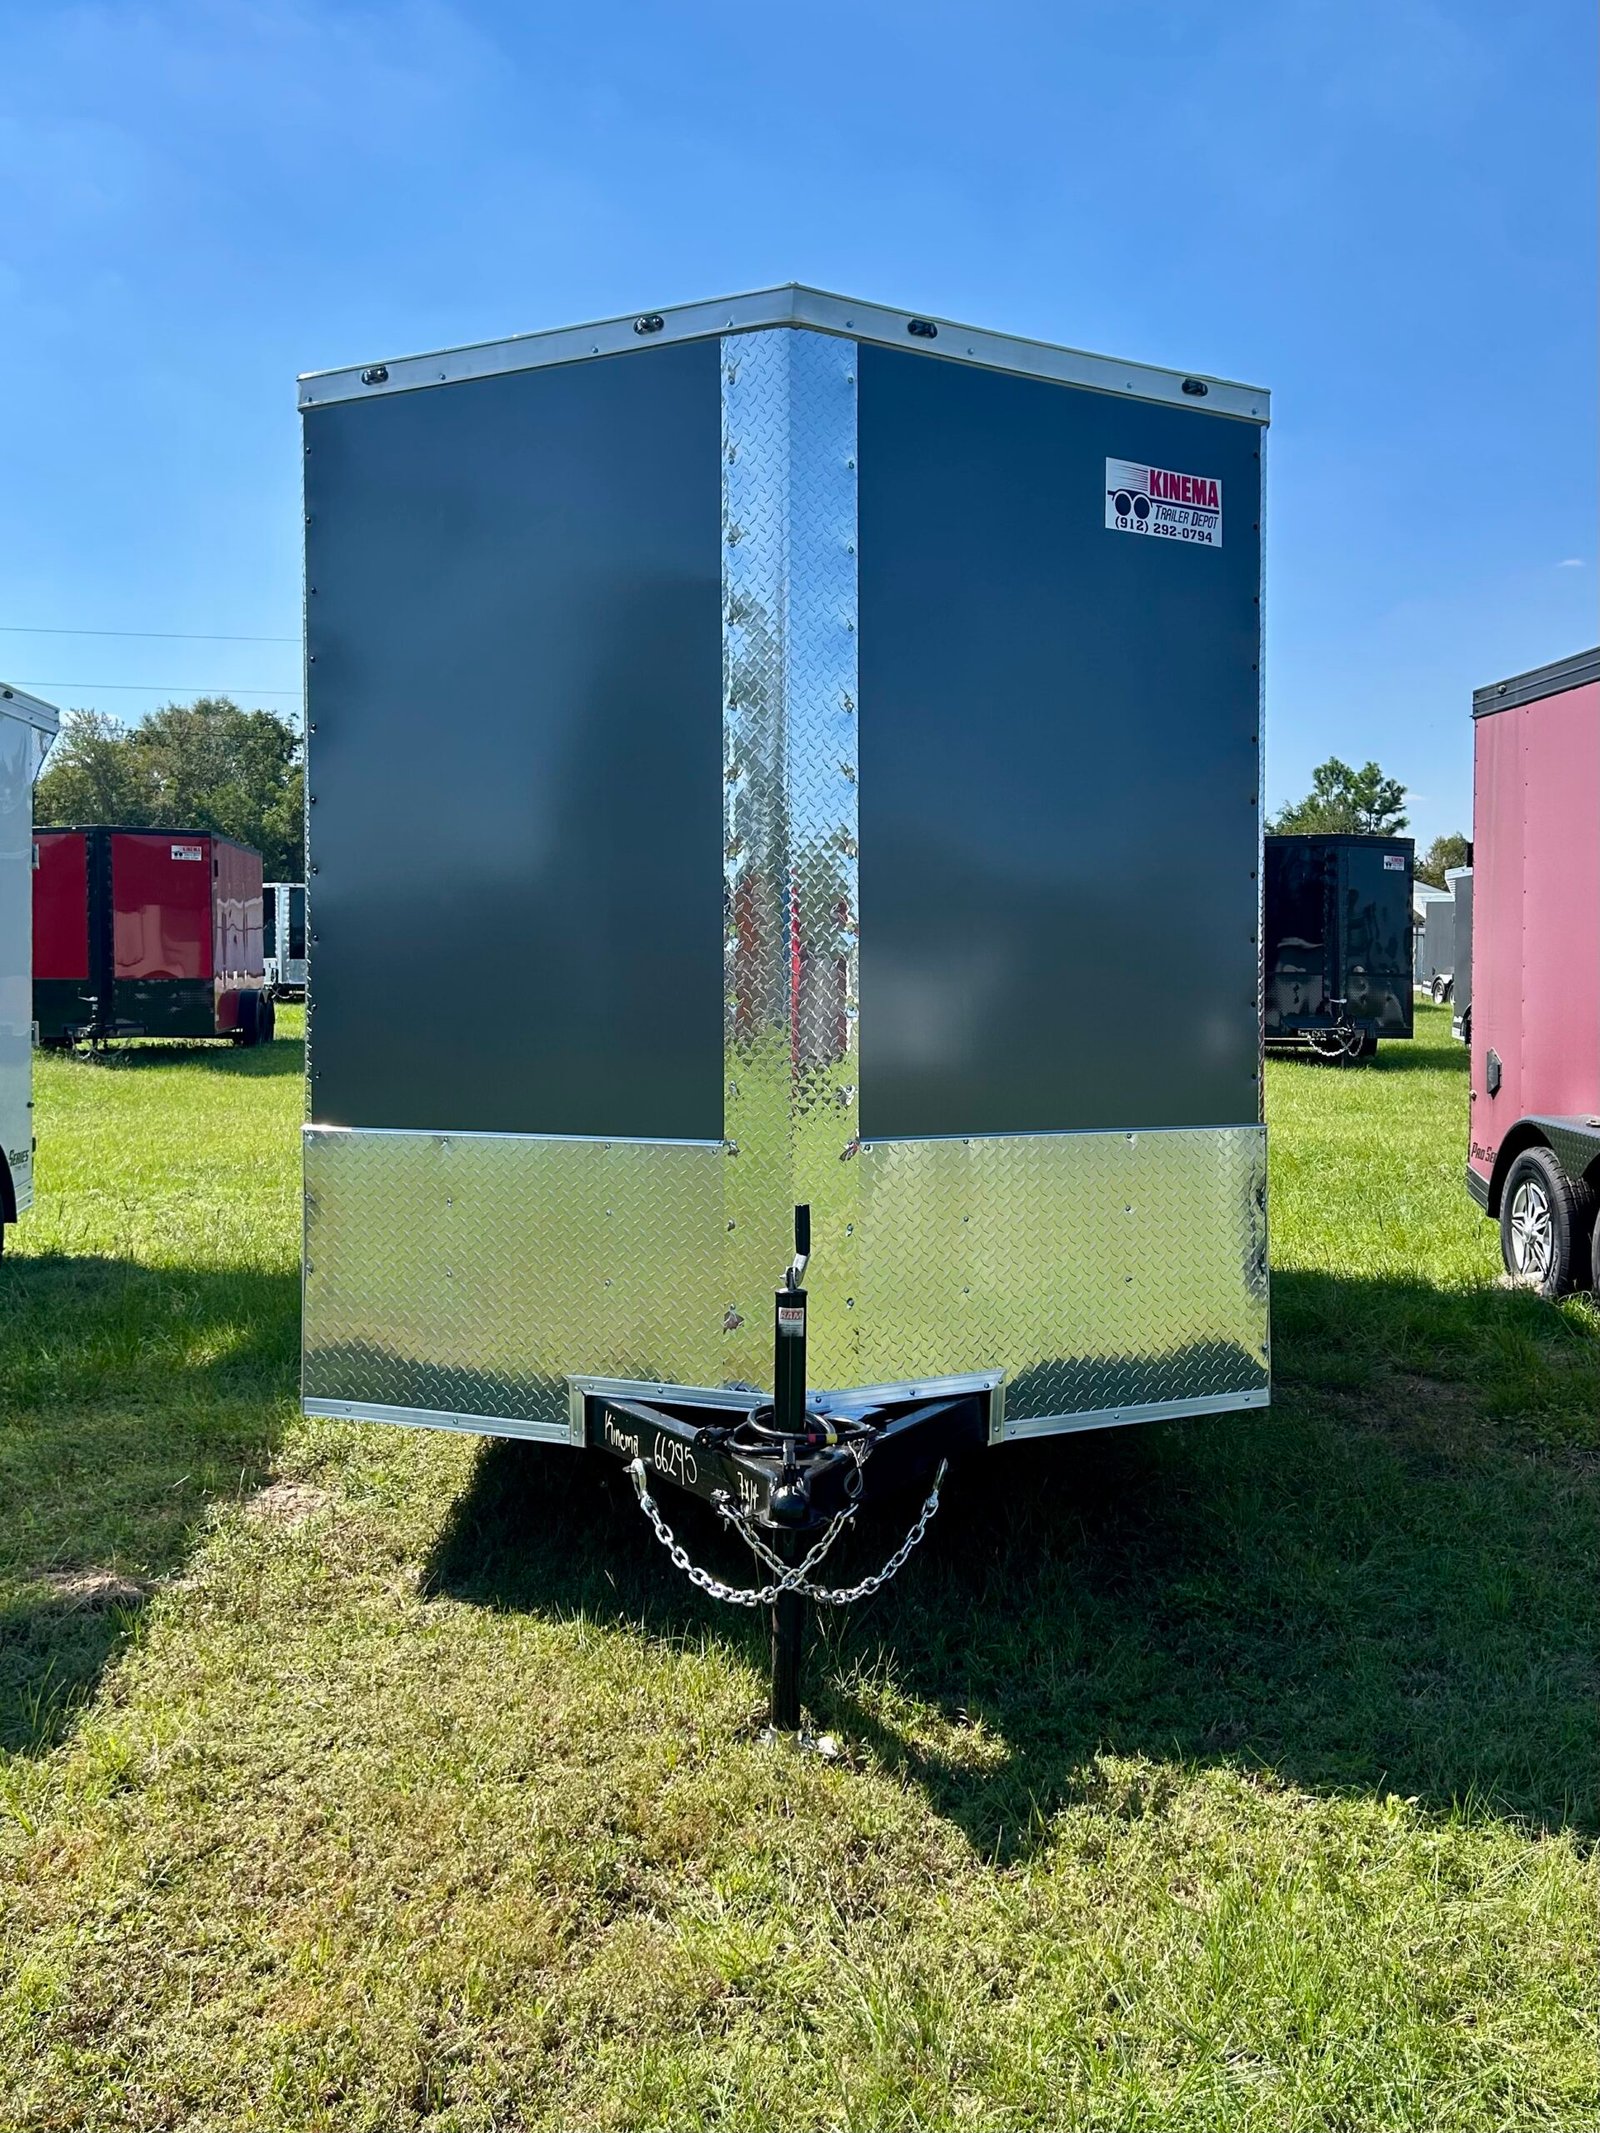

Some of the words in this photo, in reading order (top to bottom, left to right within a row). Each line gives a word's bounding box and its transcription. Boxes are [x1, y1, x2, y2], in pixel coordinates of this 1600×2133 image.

[1149, 469, 1219, 508] KINEMA
[1115, 516, 1149, 533] (912)
[1153, 522, 1213, 543] 292-0794
[1155, 505, 1189, 525] TRAILER
[1190, 511, 1219, 529] DEPOT
[604, 1410, 639, 1458] Kinema
[654, 1431, 698, 1486] 66295
